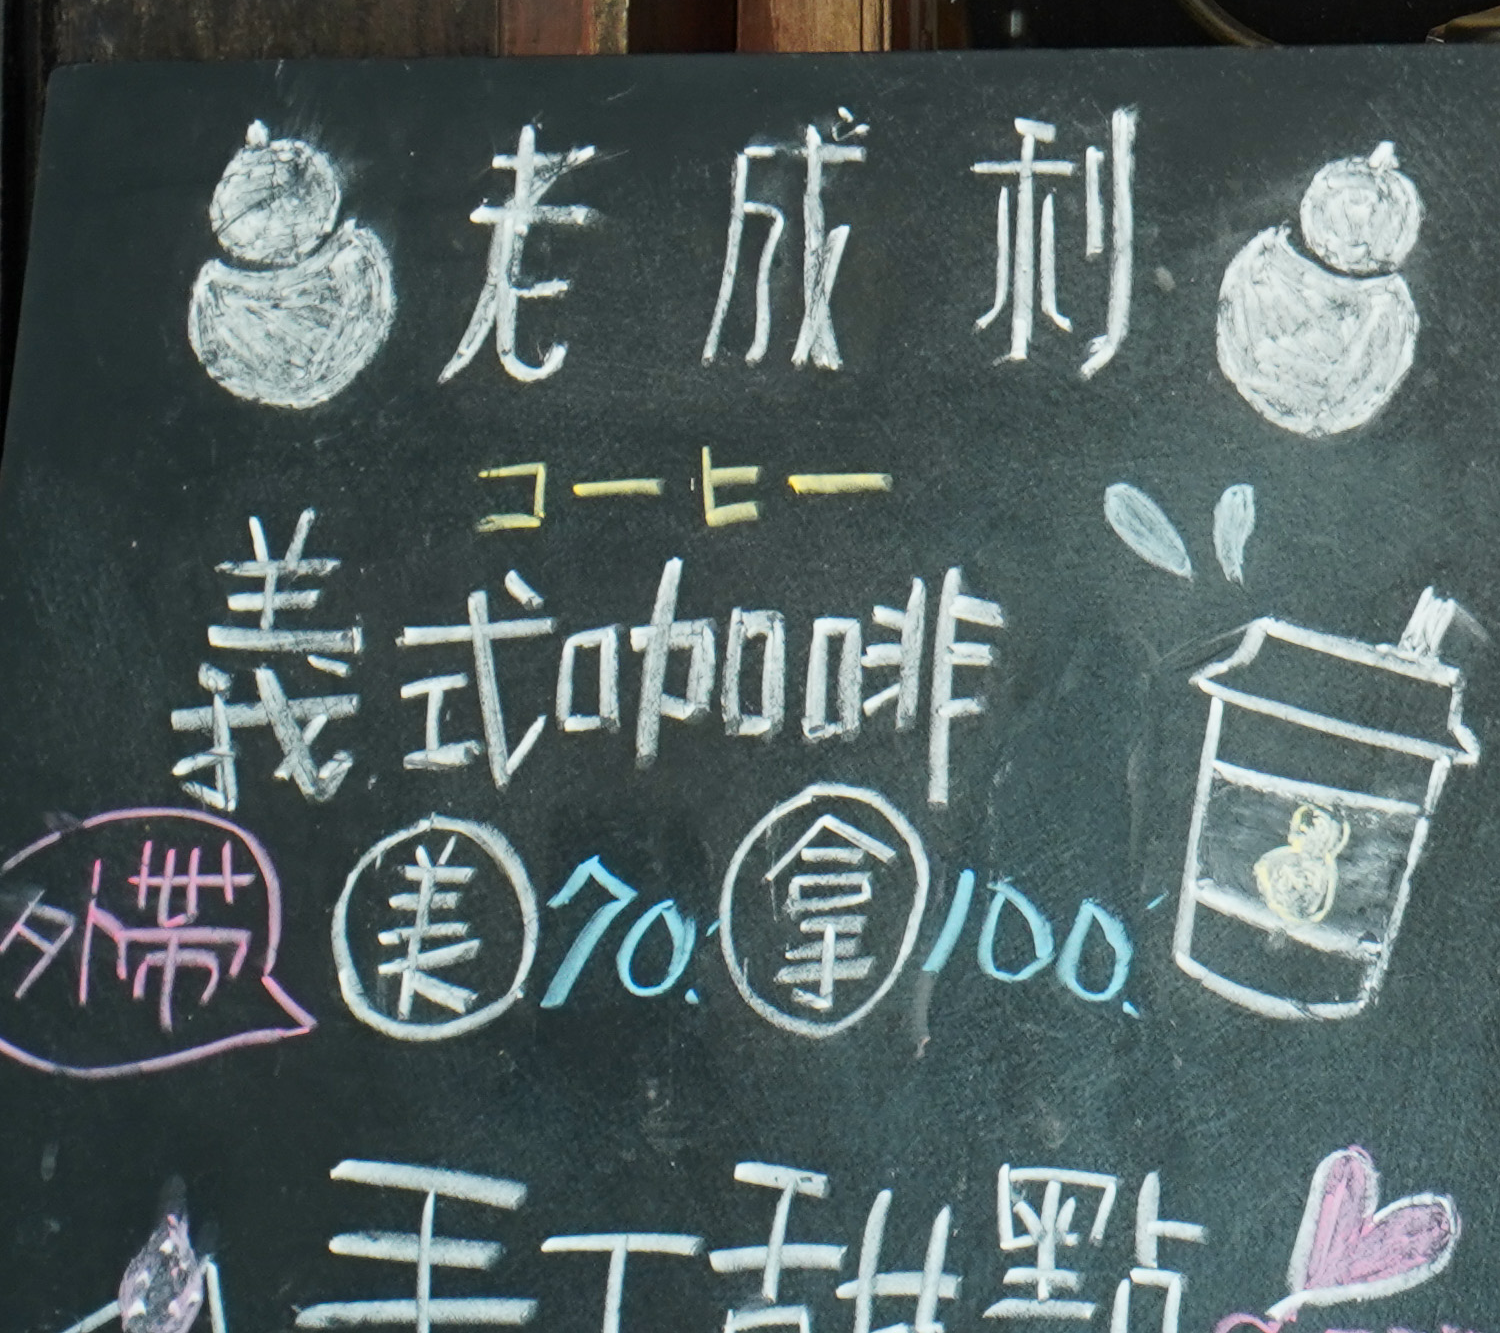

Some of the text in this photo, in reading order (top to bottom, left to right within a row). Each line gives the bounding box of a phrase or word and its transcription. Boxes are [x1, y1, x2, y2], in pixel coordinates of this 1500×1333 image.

[437, 105, 1138, 385] 老成利
[473, 445, 894, 533] コーヒー
[170, 507, 1004, 811] 義式咖啡
